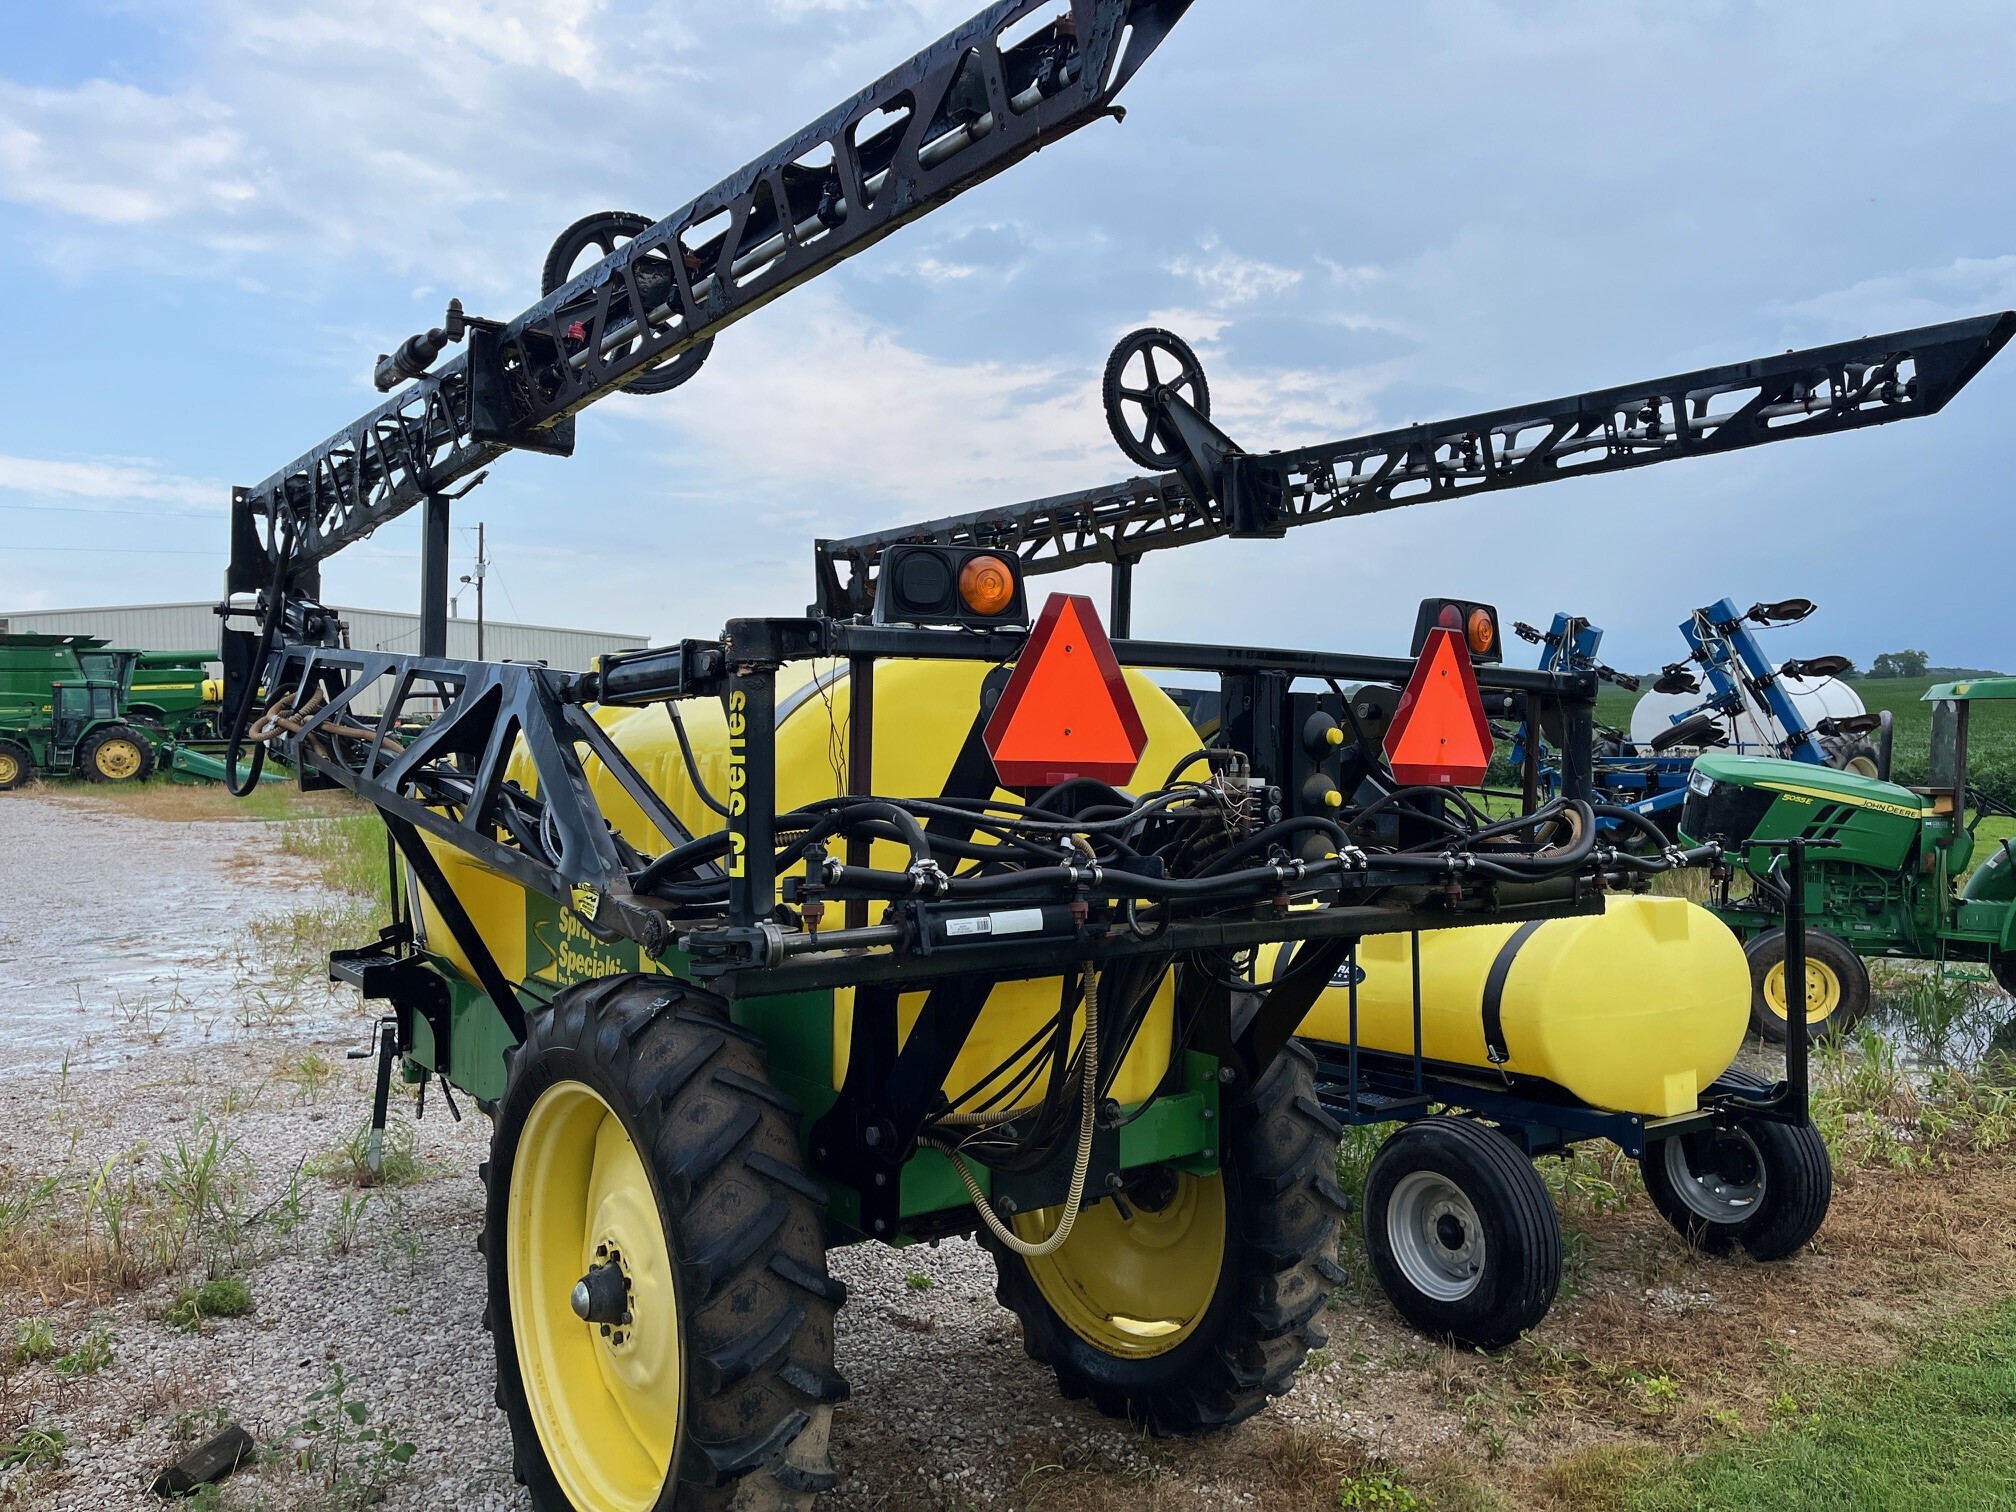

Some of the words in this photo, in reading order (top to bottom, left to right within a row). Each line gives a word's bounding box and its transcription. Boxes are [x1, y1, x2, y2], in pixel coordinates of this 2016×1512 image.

[729, 690, 746, 817] Series
[1860, 800, 1887, 811] JOHN
[1886, 805, 1918, 819] DEERE
[558, 905, 610, 949] Spray
[558, 940, 628, 979] Specialti
